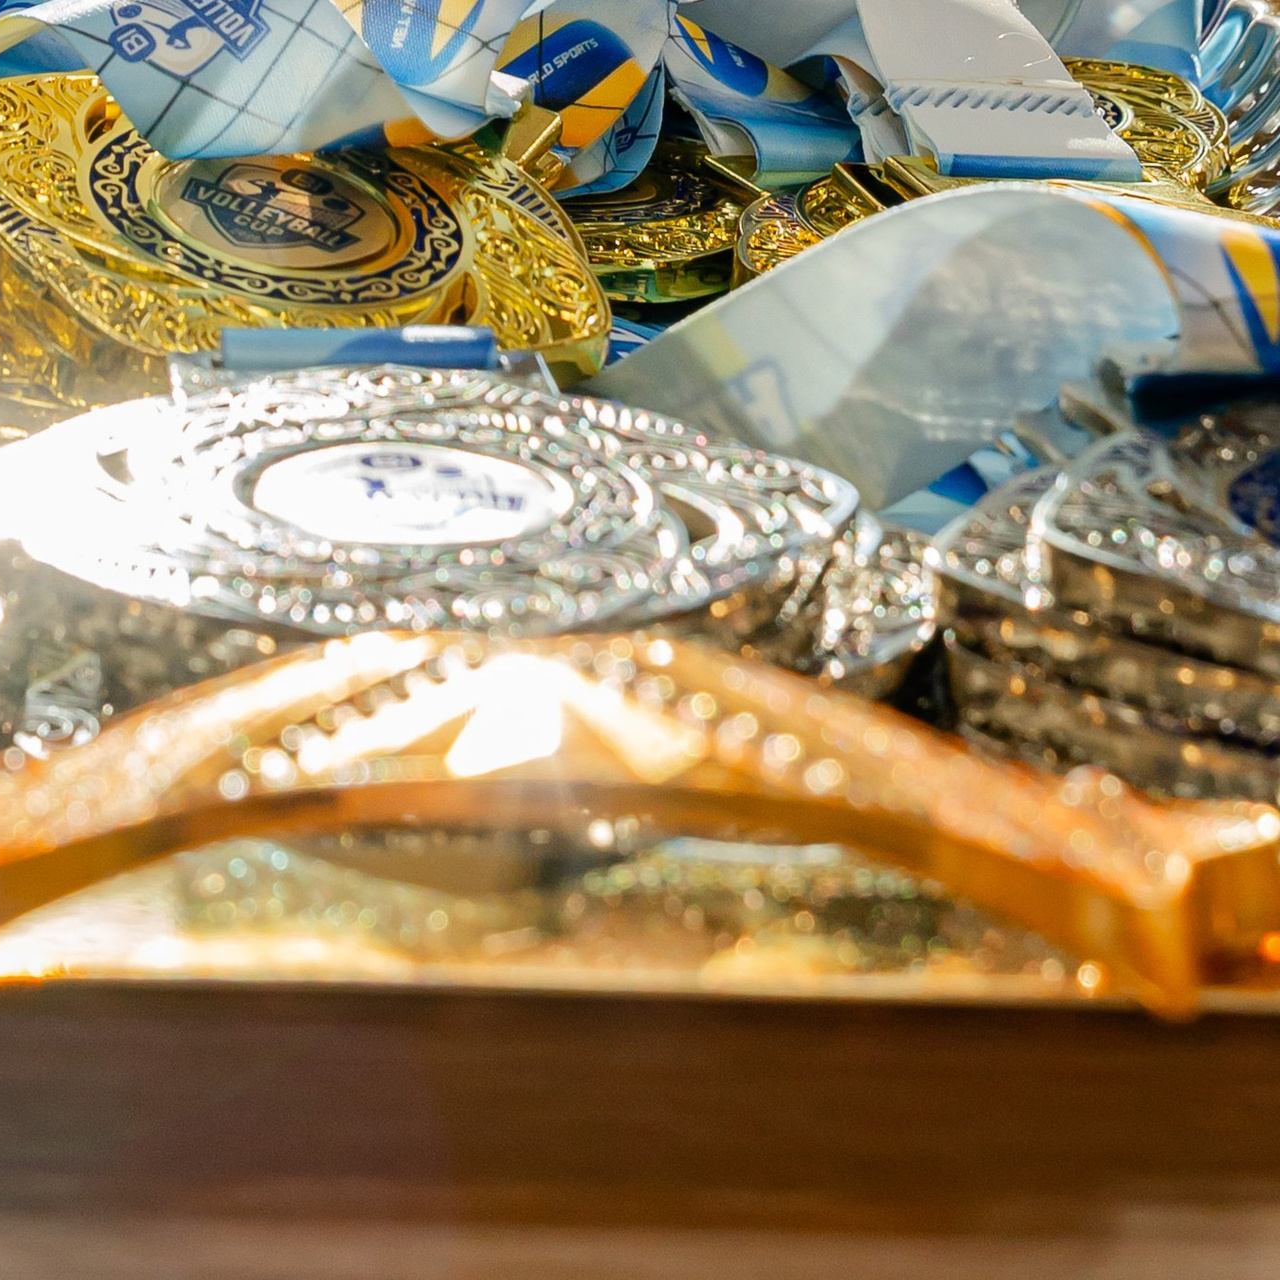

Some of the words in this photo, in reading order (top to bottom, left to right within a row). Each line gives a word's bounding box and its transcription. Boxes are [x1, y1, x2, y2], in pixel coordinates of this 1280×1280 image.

[116, 27, 151, 57] BI
[527, 62, 555, 87] RLD
[554, 37, 599, 69] SPORTS
[196, 186, 342, 247] VOLLEYBALL
[232, 214, 285, 237] CUP
